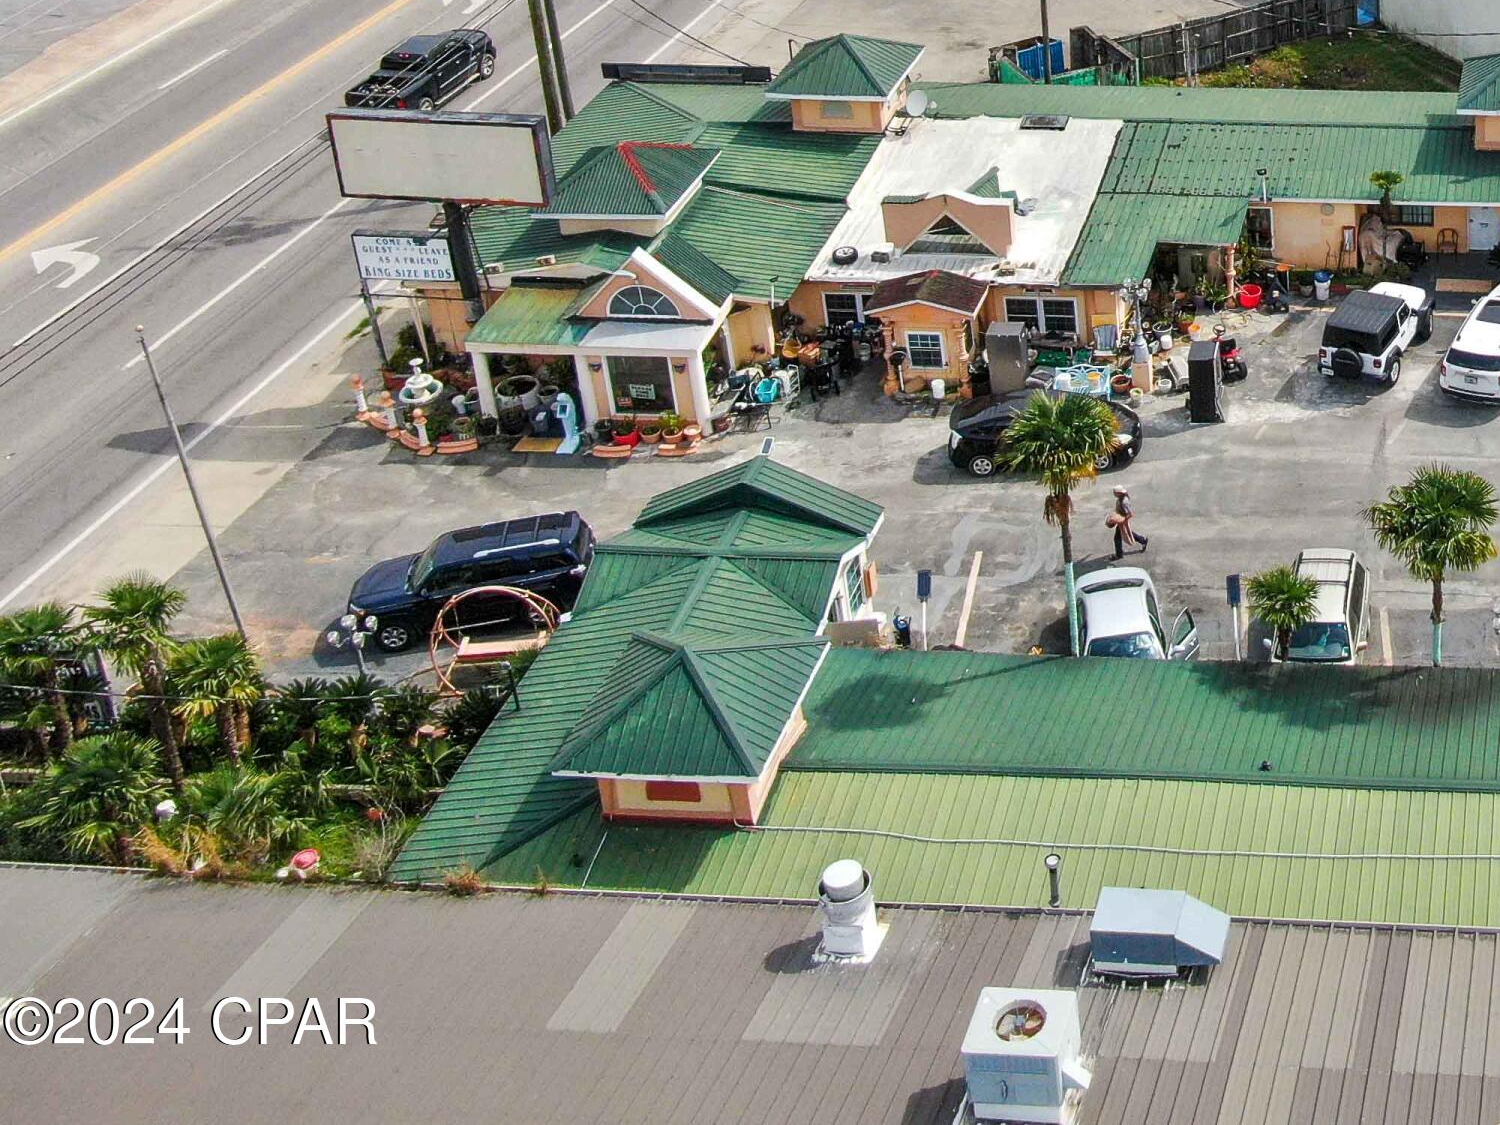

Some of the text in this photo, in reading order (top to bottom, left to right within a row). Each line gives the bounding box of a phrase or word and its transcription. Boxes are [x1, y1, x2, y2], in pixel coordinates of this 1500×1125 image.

[362, 245, 449, 256] GUEST LEAVE
[379, 256, 391, 264] AS
[404, 257, 439, 265] FRIEND
[364, 265, 452, 279] KING SIZE BEDS
